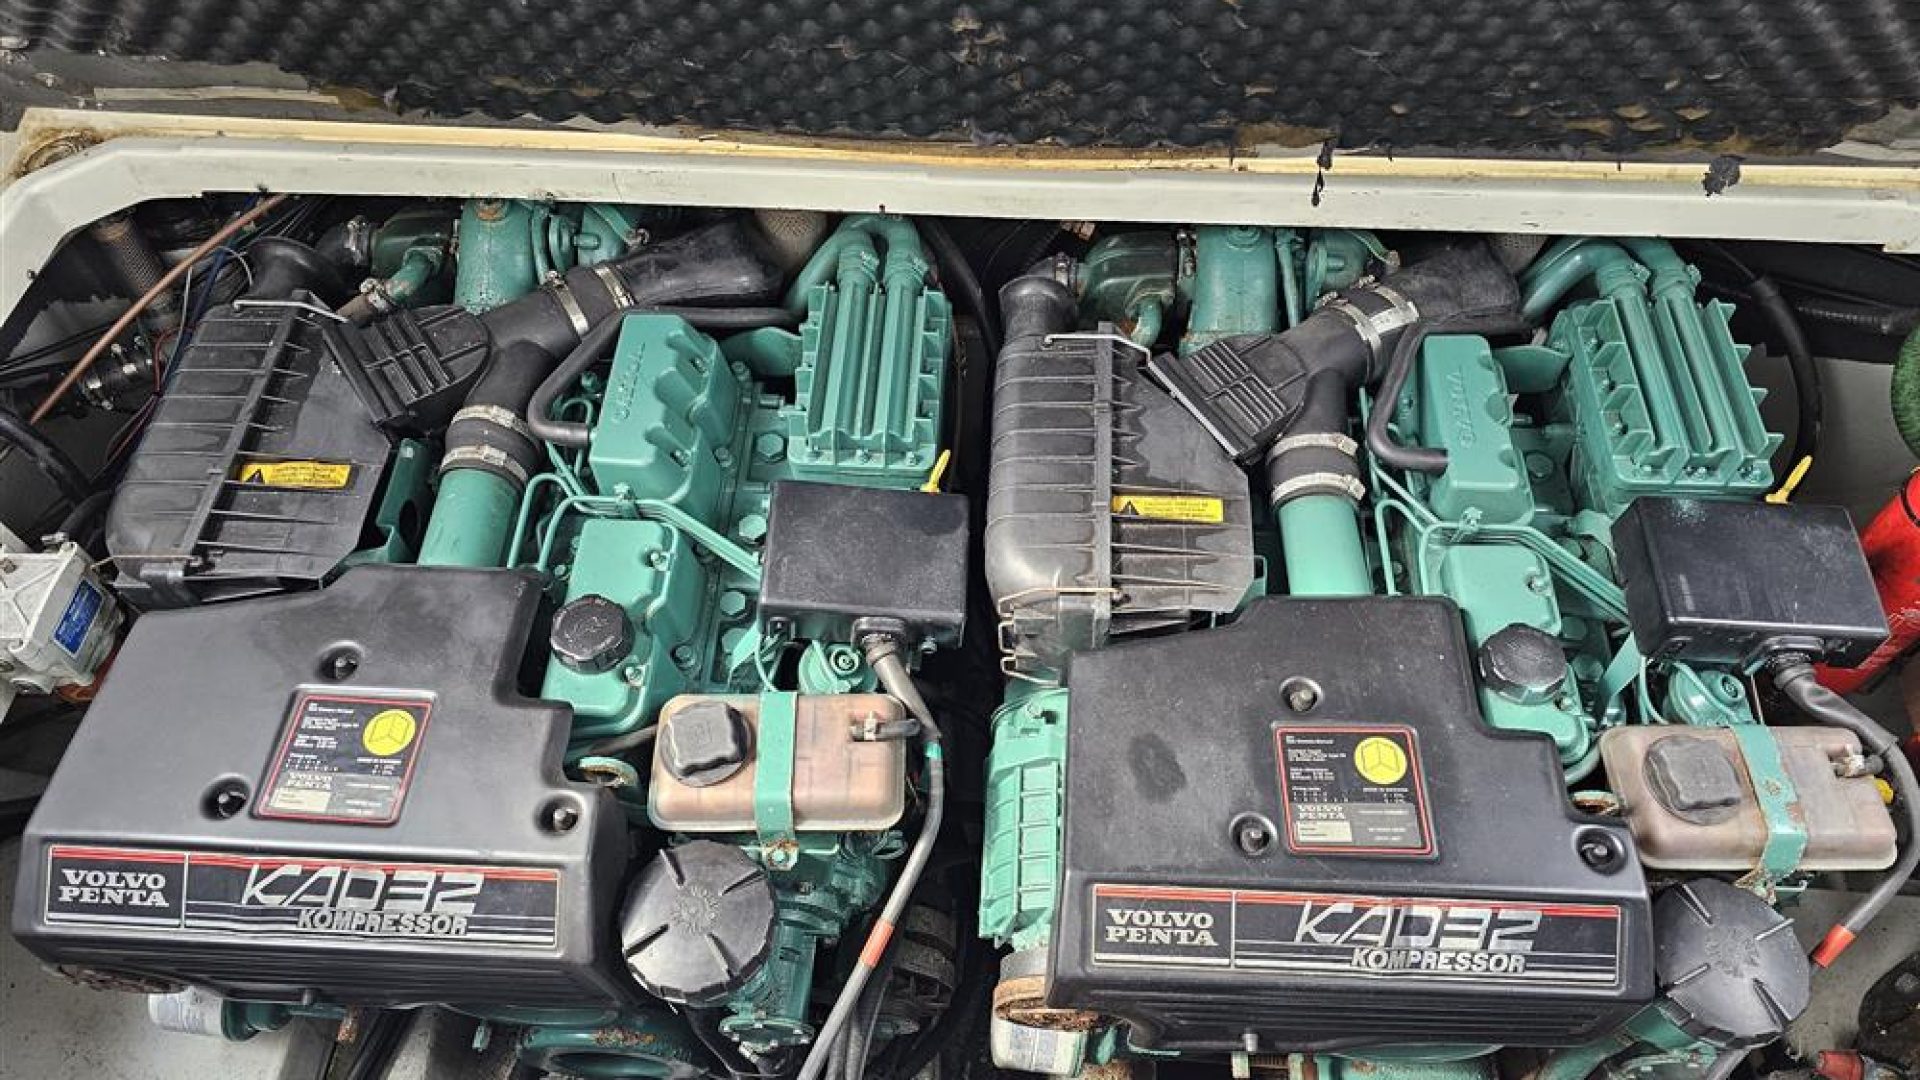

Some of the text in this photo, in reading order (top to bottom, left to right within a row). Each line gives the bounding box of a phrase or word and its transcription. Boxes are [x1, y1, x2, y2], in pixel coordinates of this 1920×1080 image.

[62, 868, 166, 889] VOLVO
[241, 863, 486, 914] KAD32
[59, 886, 169, 907] PENTA
[298, 909, 468, 936] KOMPRESSOR
[1106, 909, 1214, 928] VOLVO
[1295, 901, 1543, 953] KAD32
[1105, 927, 1218, 946] PENTA
[1350, 947, 1527, 974] KOMPRESSOR
